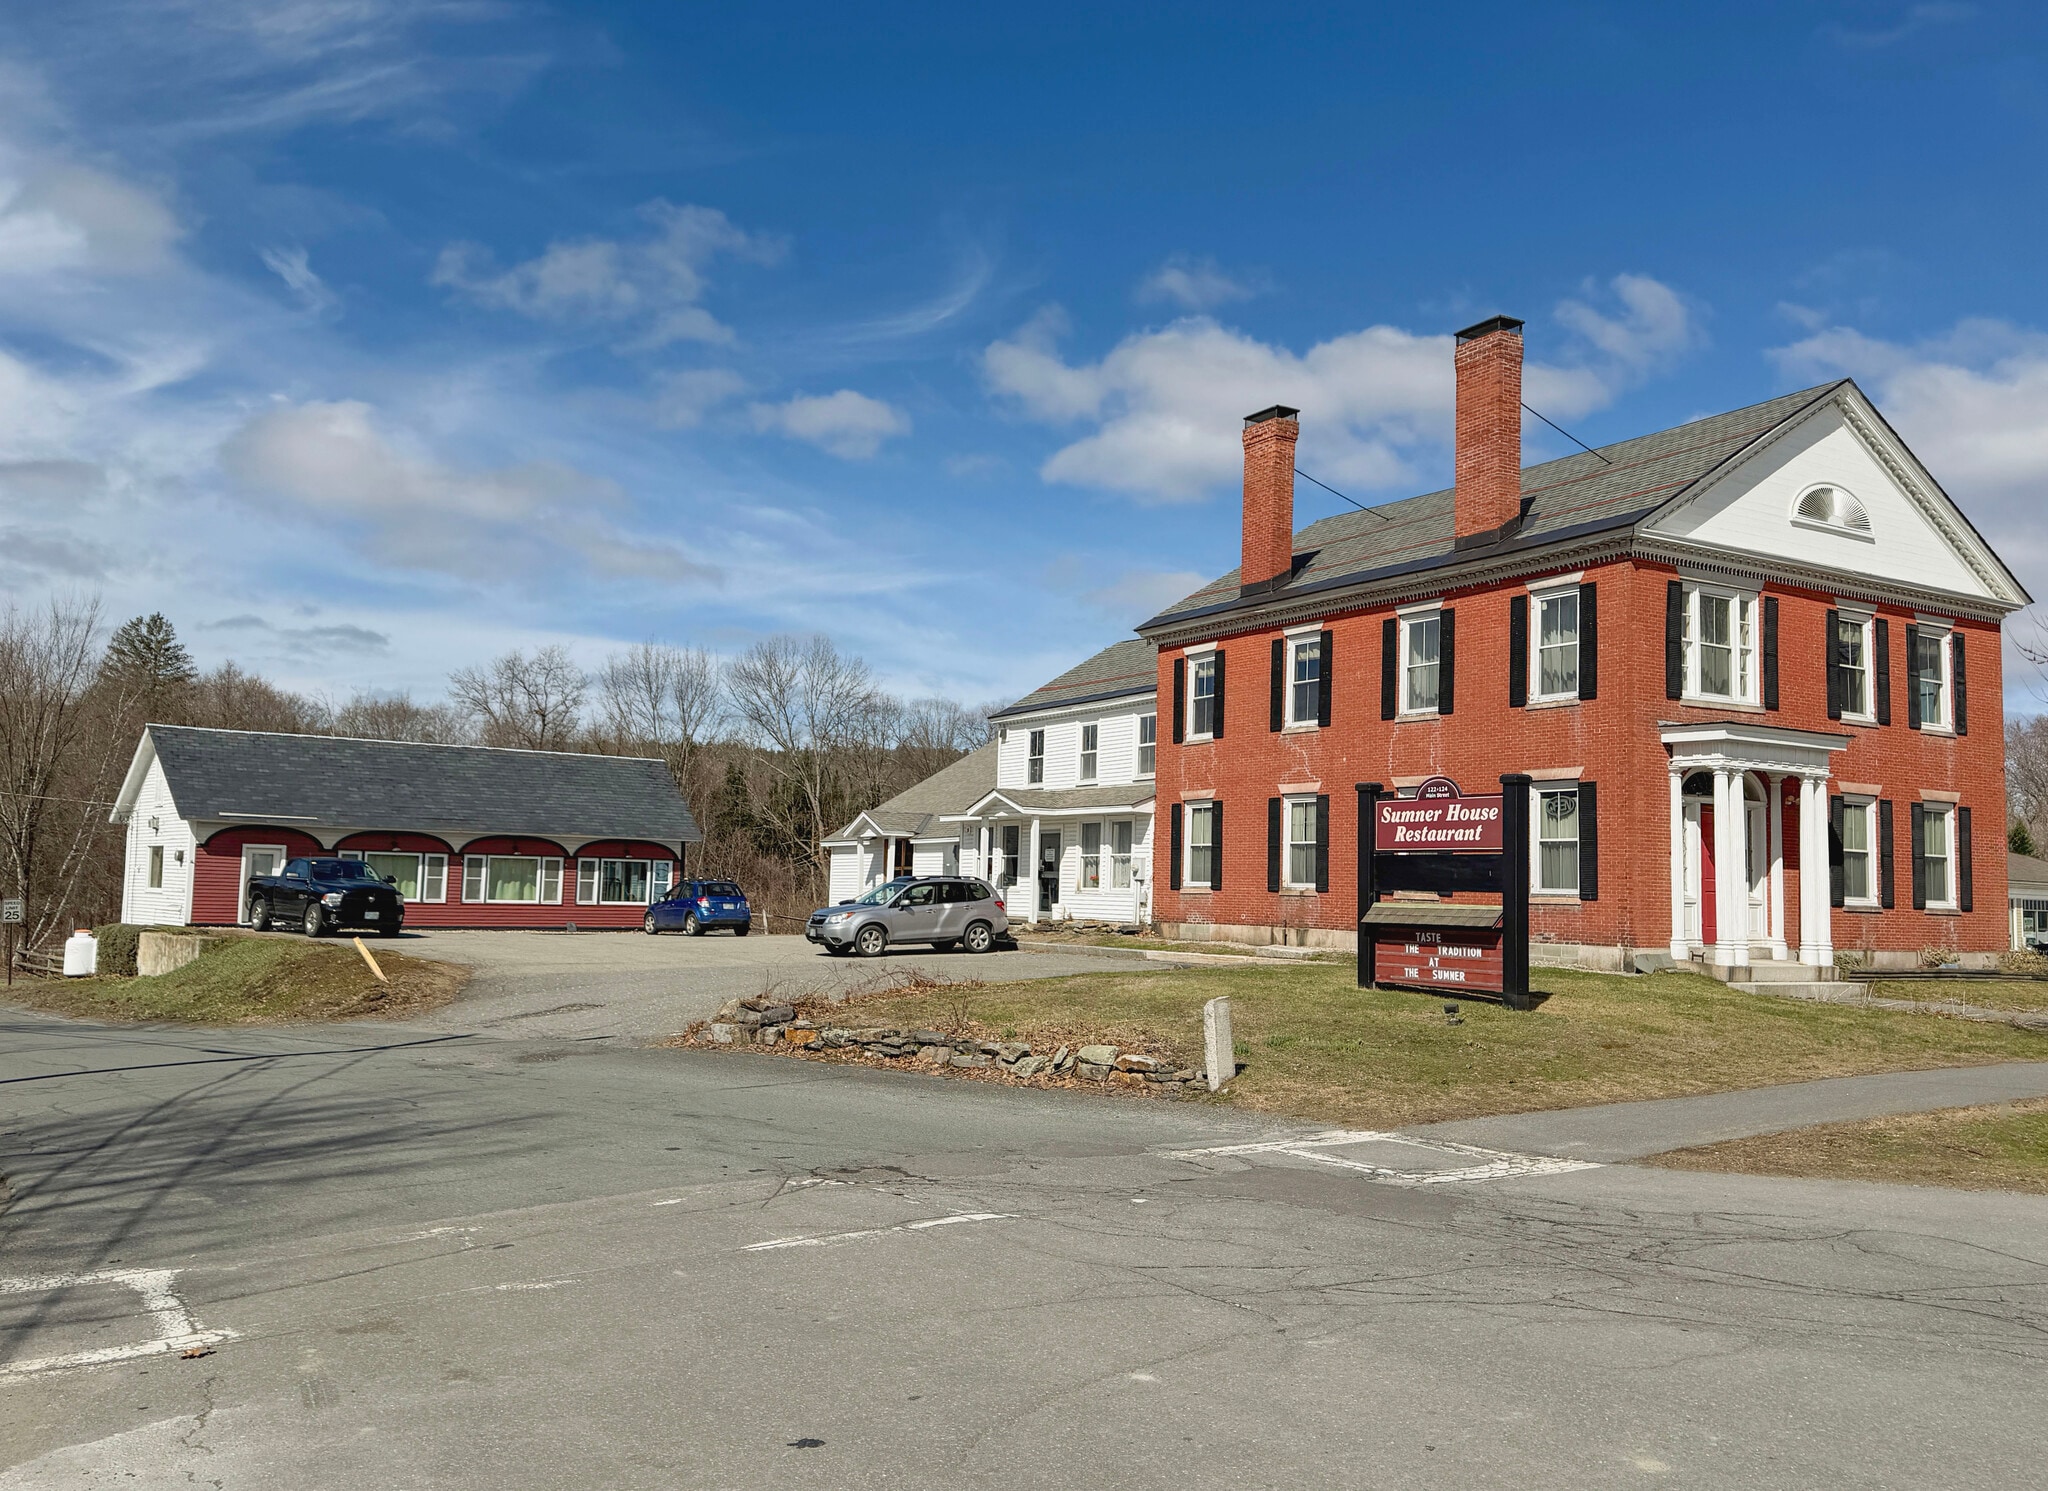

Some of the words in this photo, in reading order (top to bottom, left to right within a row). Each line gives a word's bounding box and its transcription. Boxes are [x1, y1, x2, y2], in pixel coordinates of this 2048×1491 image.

[1547, 800, 1573, 813] OPEN
[1381, 806, 1442, 824] Sumner
[1446, 803, 1499, 822] House
[1394, 824, 1483, 842] Restaurant
[4, 910, 20, 920] 25
[1415, 932, 1442, 943] TASTE
[1404, 944, 1420, 954] THE
[1437, 945, 1482, 958] TRADITION
[1428, 957, 1440, 967] AT
[1404, 967, 1419, 978] THE
[1432, 969, 1466, 982] SUMNER
